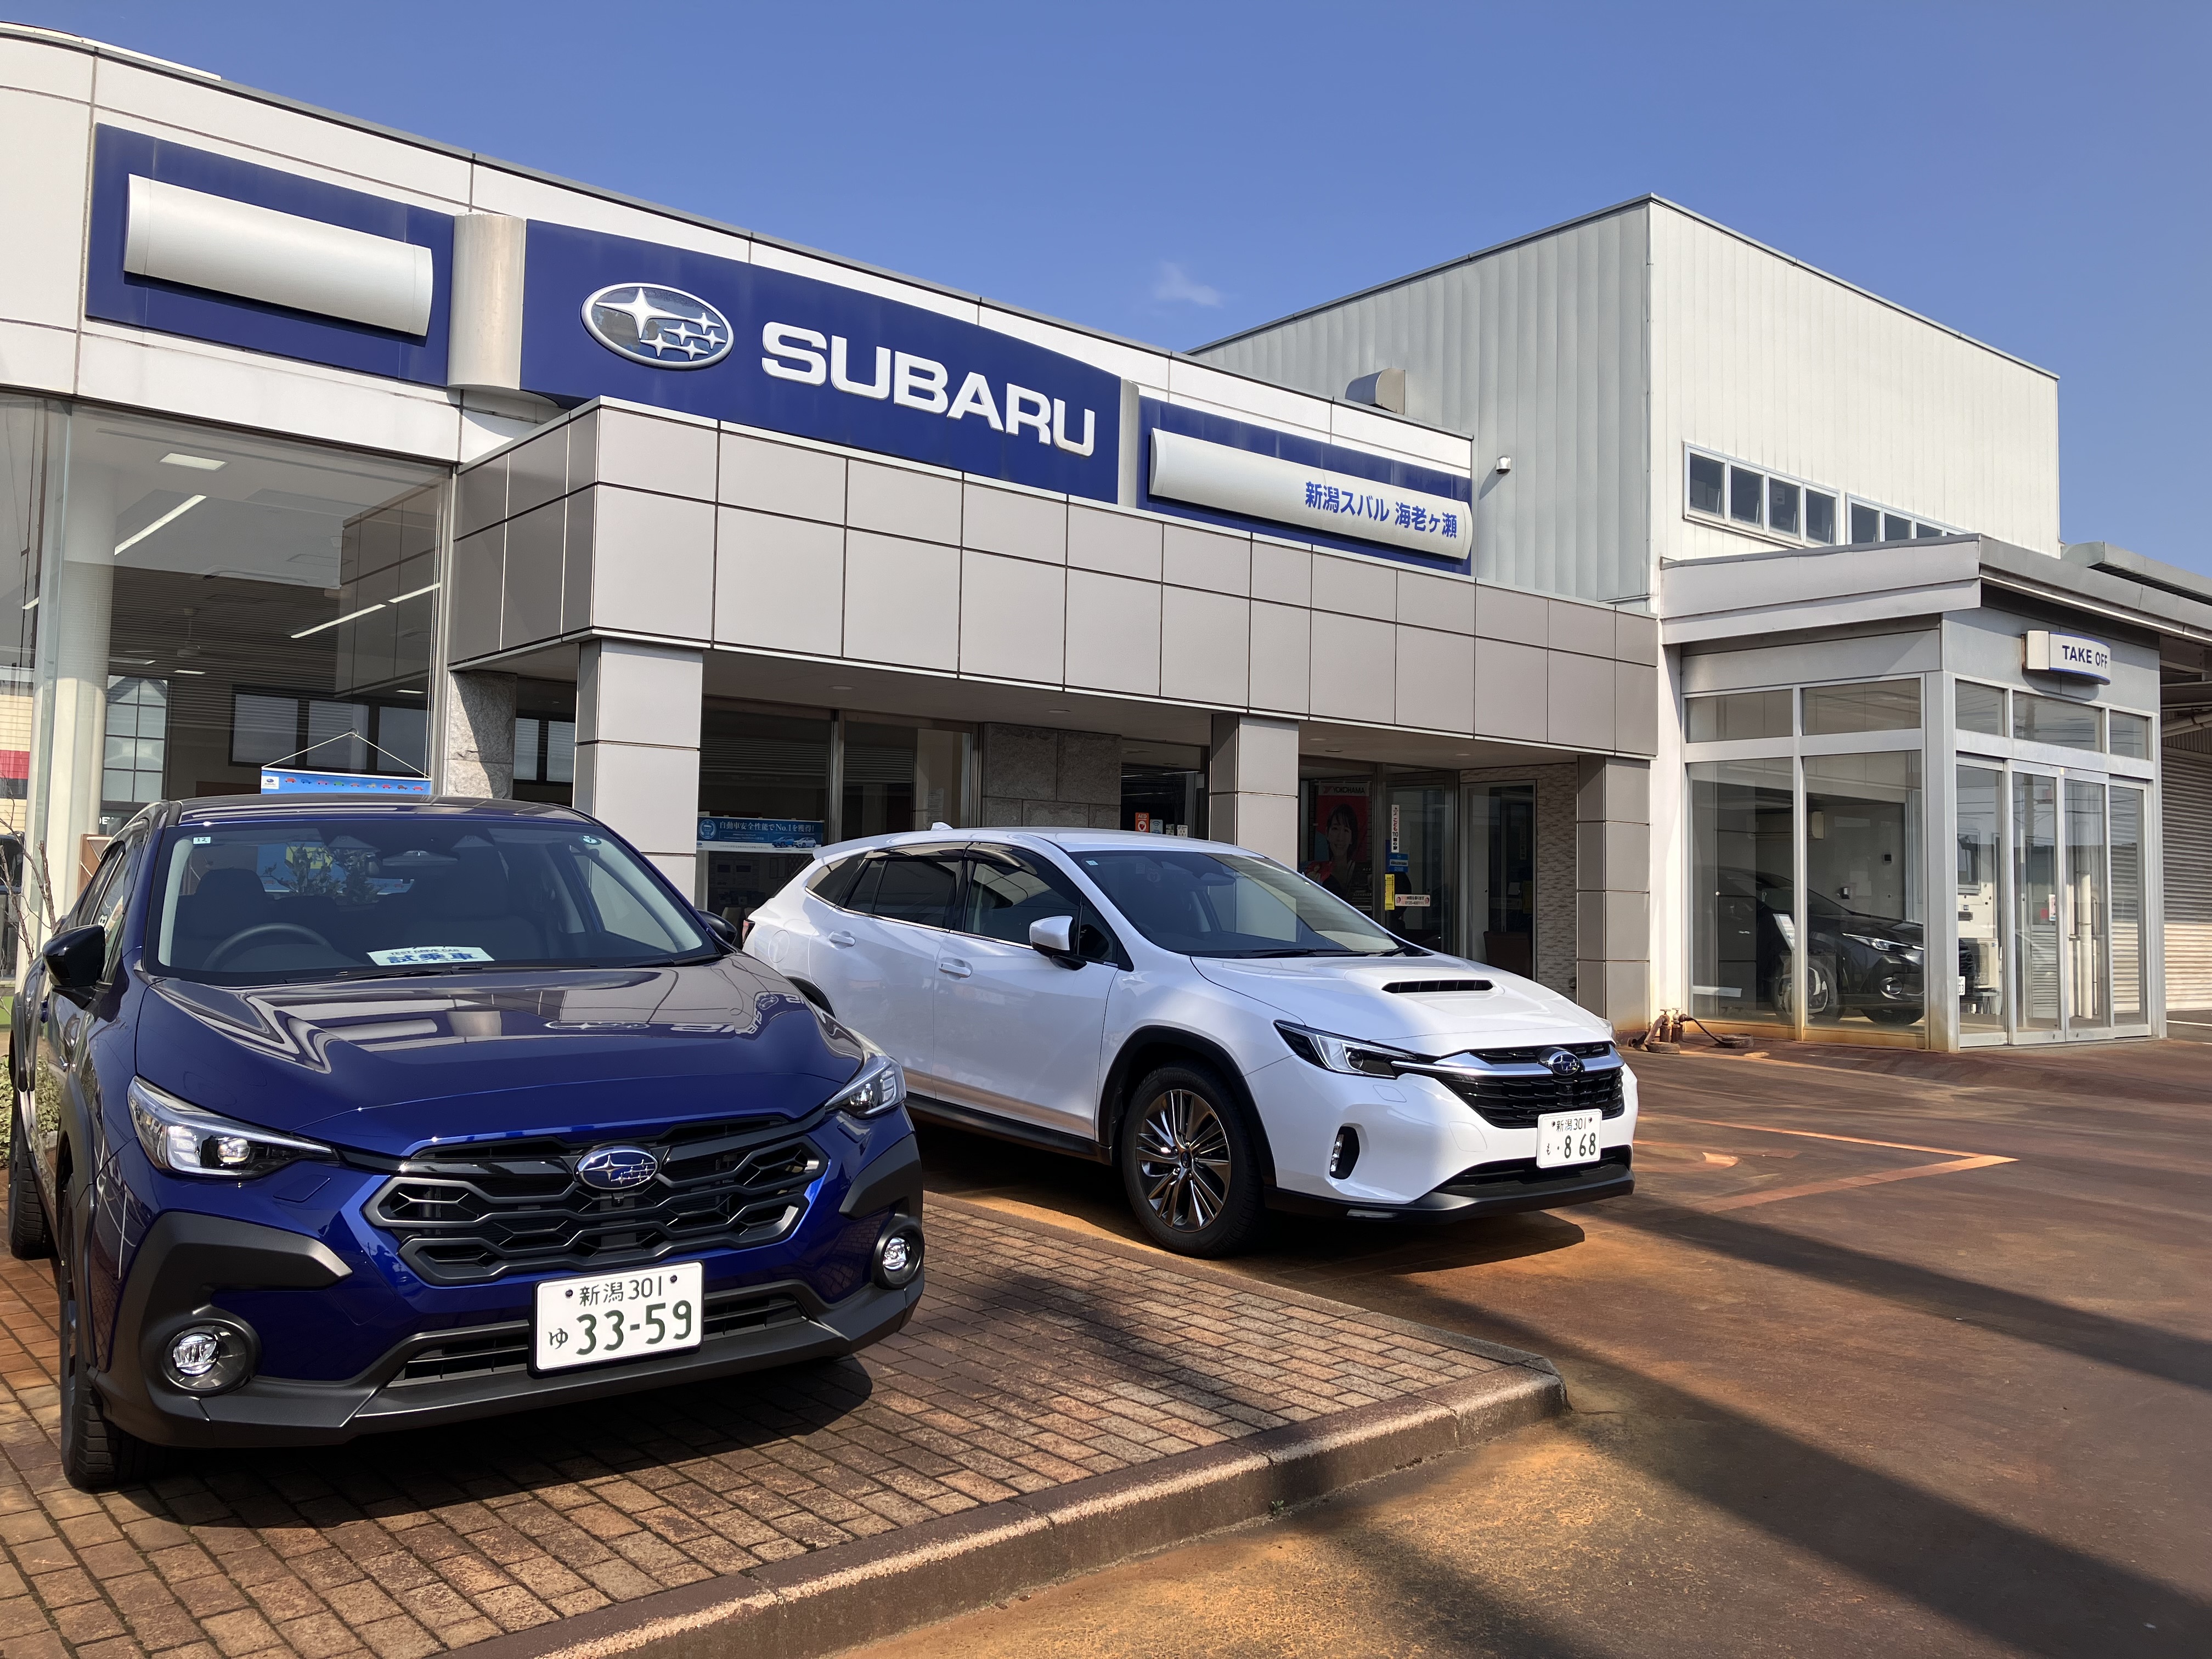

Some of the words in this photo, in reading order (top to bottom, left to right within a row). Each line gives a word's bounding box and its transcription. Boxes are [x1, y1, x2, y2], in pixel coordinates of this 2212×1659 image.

[761, 321, 1096, 457] SUBARU
[1305, 481, 1390, 522] 新潟スバル
[2062, 645, 2092, 664] TAKE
[2095, 651, 2108, 669] OFF
[548, 1328, 569, 1350] ゆ
[575, 1300, 692, 1356] 33-59
